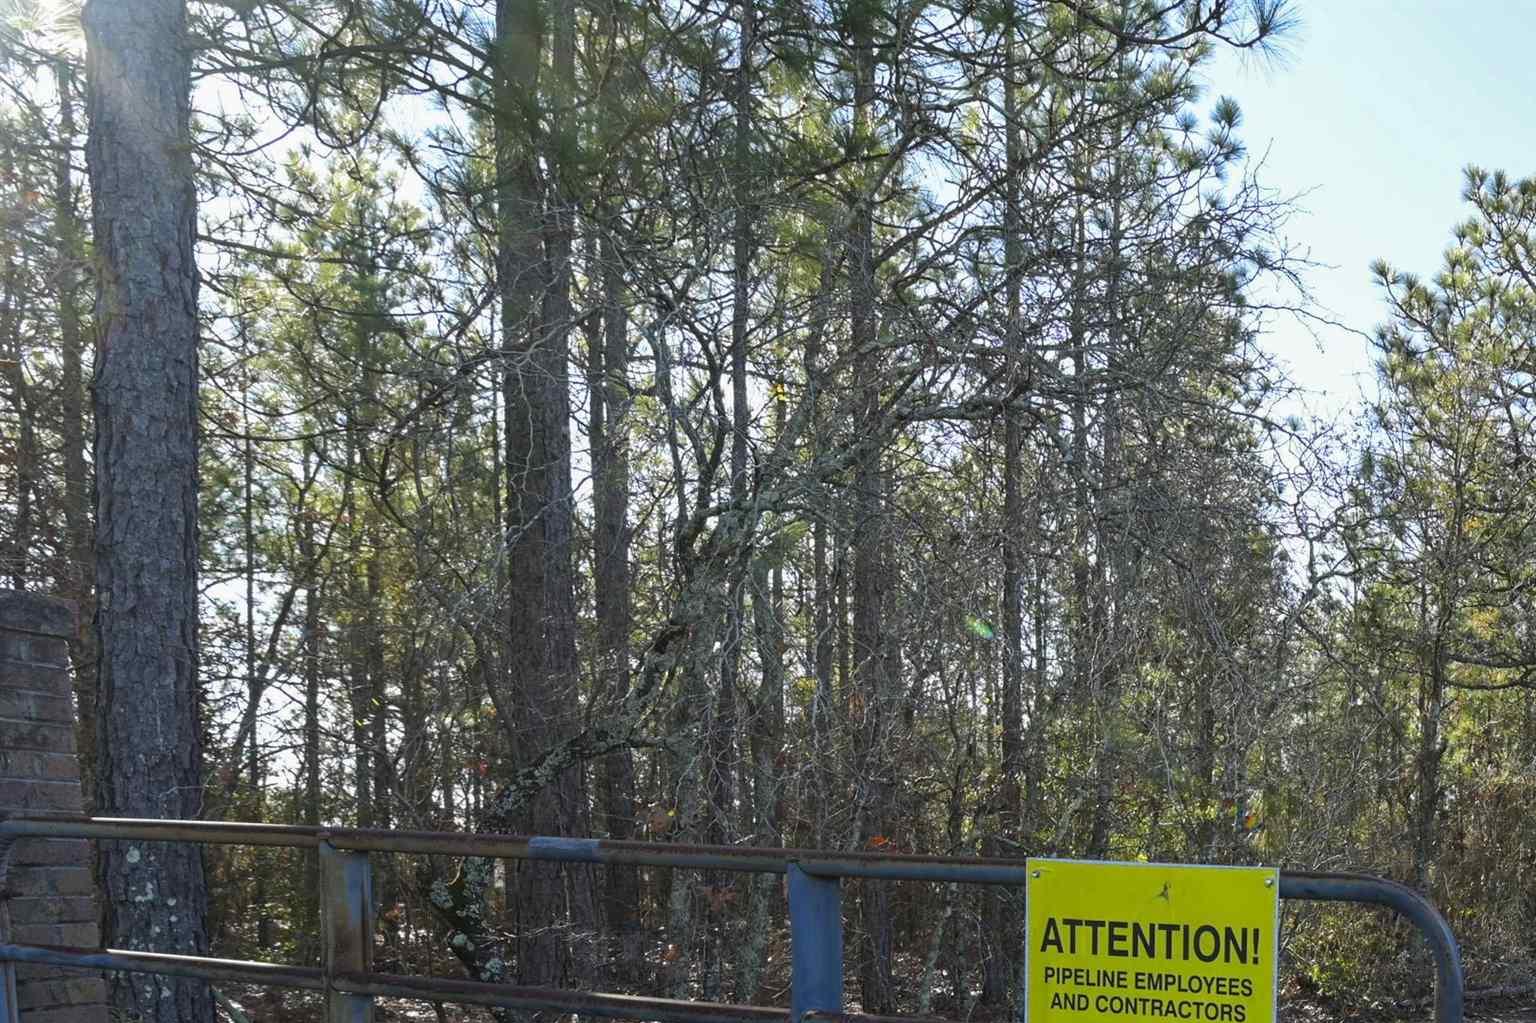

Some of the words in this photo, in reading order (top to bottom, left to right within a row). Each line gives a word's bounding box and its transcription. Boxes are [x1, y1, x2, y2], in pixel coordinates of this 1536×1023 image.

[1040, 918, 1259, 965] ATTENTION!
[1045, 967, 1127, 988] PIPELINE
[1135, 972, 1252, 997] EMPLOYEES
[1051, 993, 1089, 1011] AND
[1096, 995, 1245, 1022] CONTRACTORS
